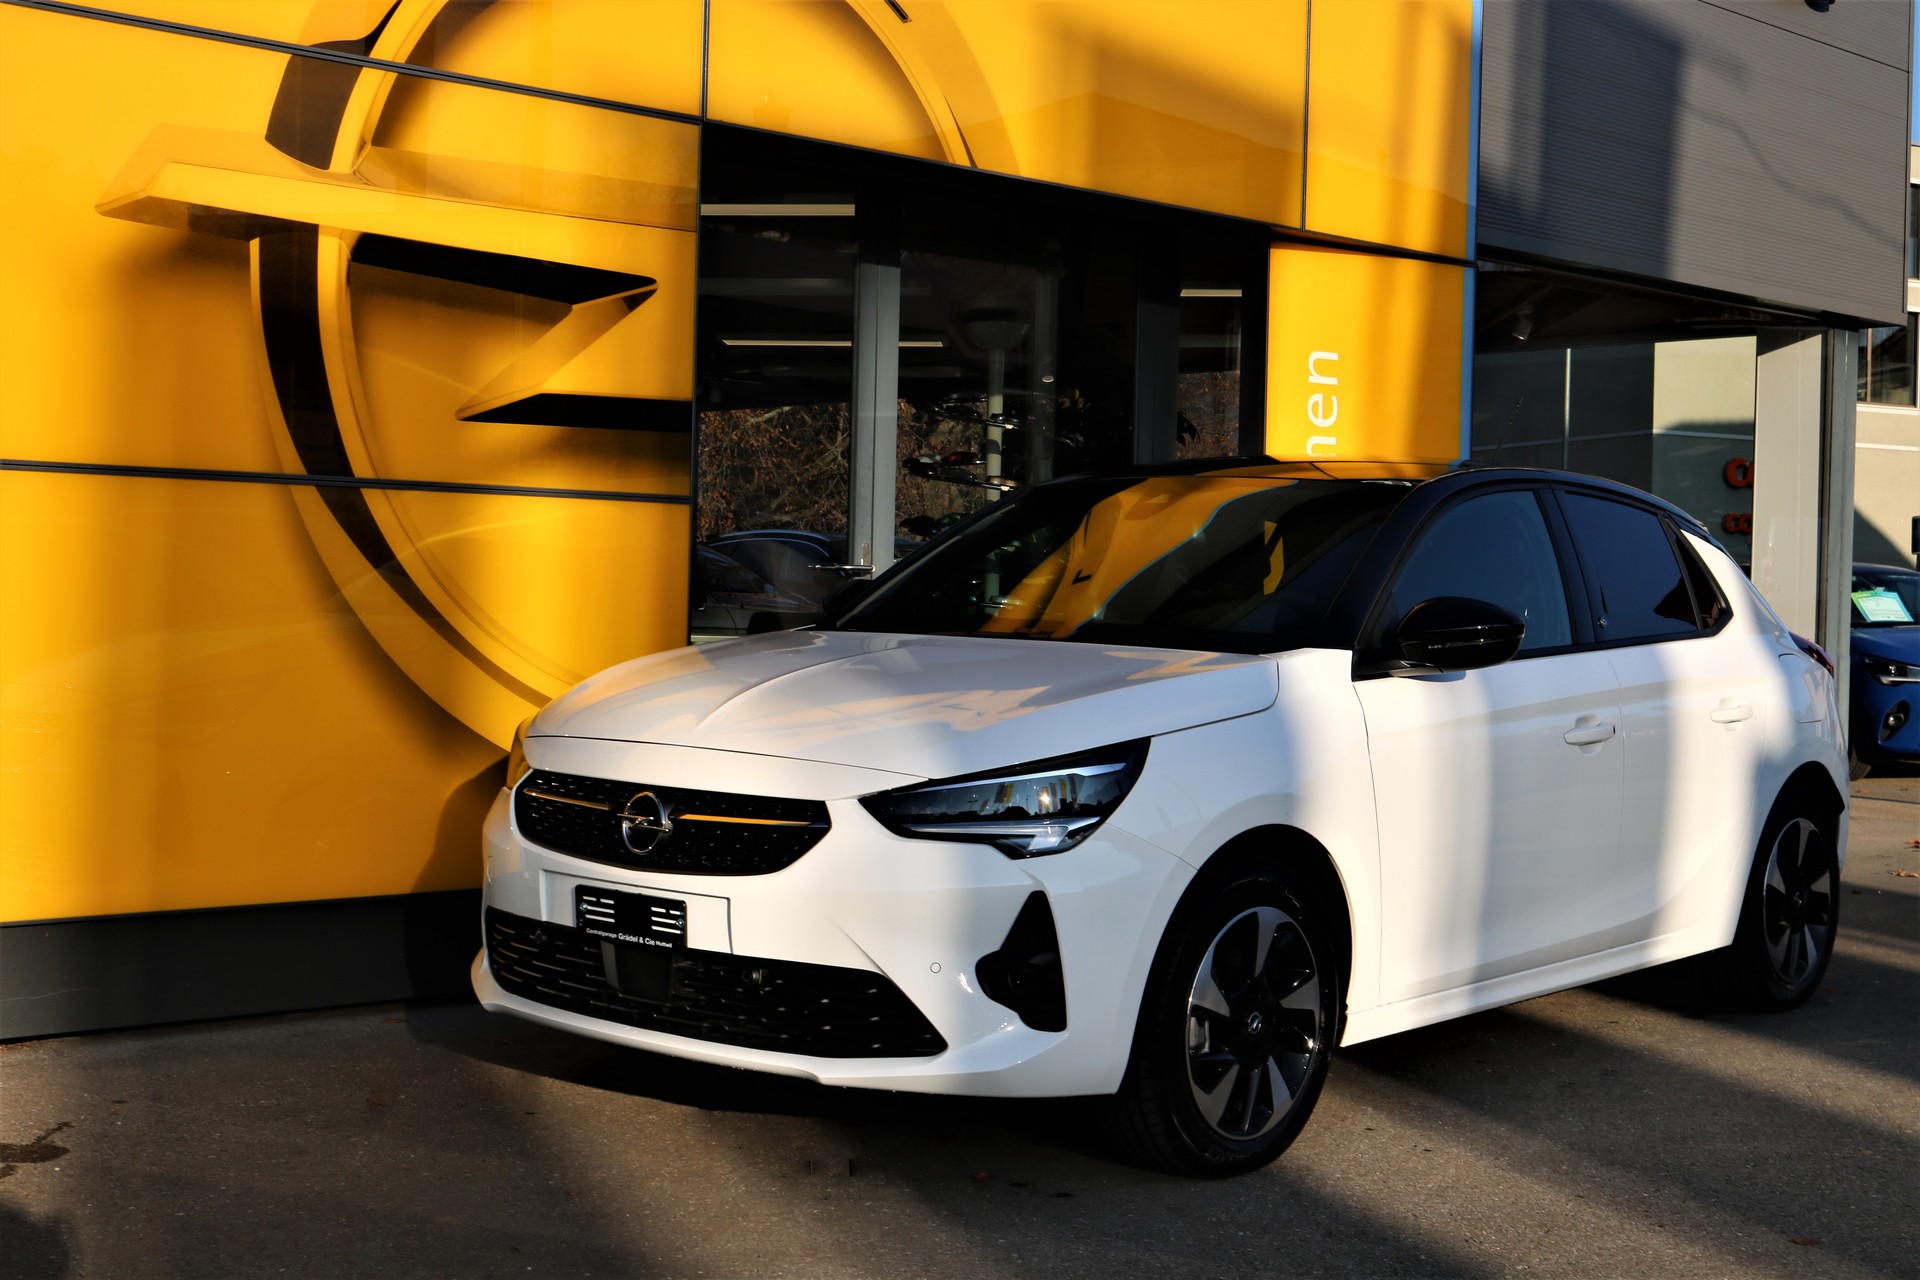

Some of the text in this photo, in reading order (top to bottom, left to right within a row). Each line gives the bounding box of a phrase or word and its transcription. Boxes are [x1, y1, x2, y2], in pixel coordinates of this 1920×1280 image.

[586, 928, 617, 939] Centralgarage
[618, 933, 638, 943] Grädel
[644, 937, 655, 946] Cie
